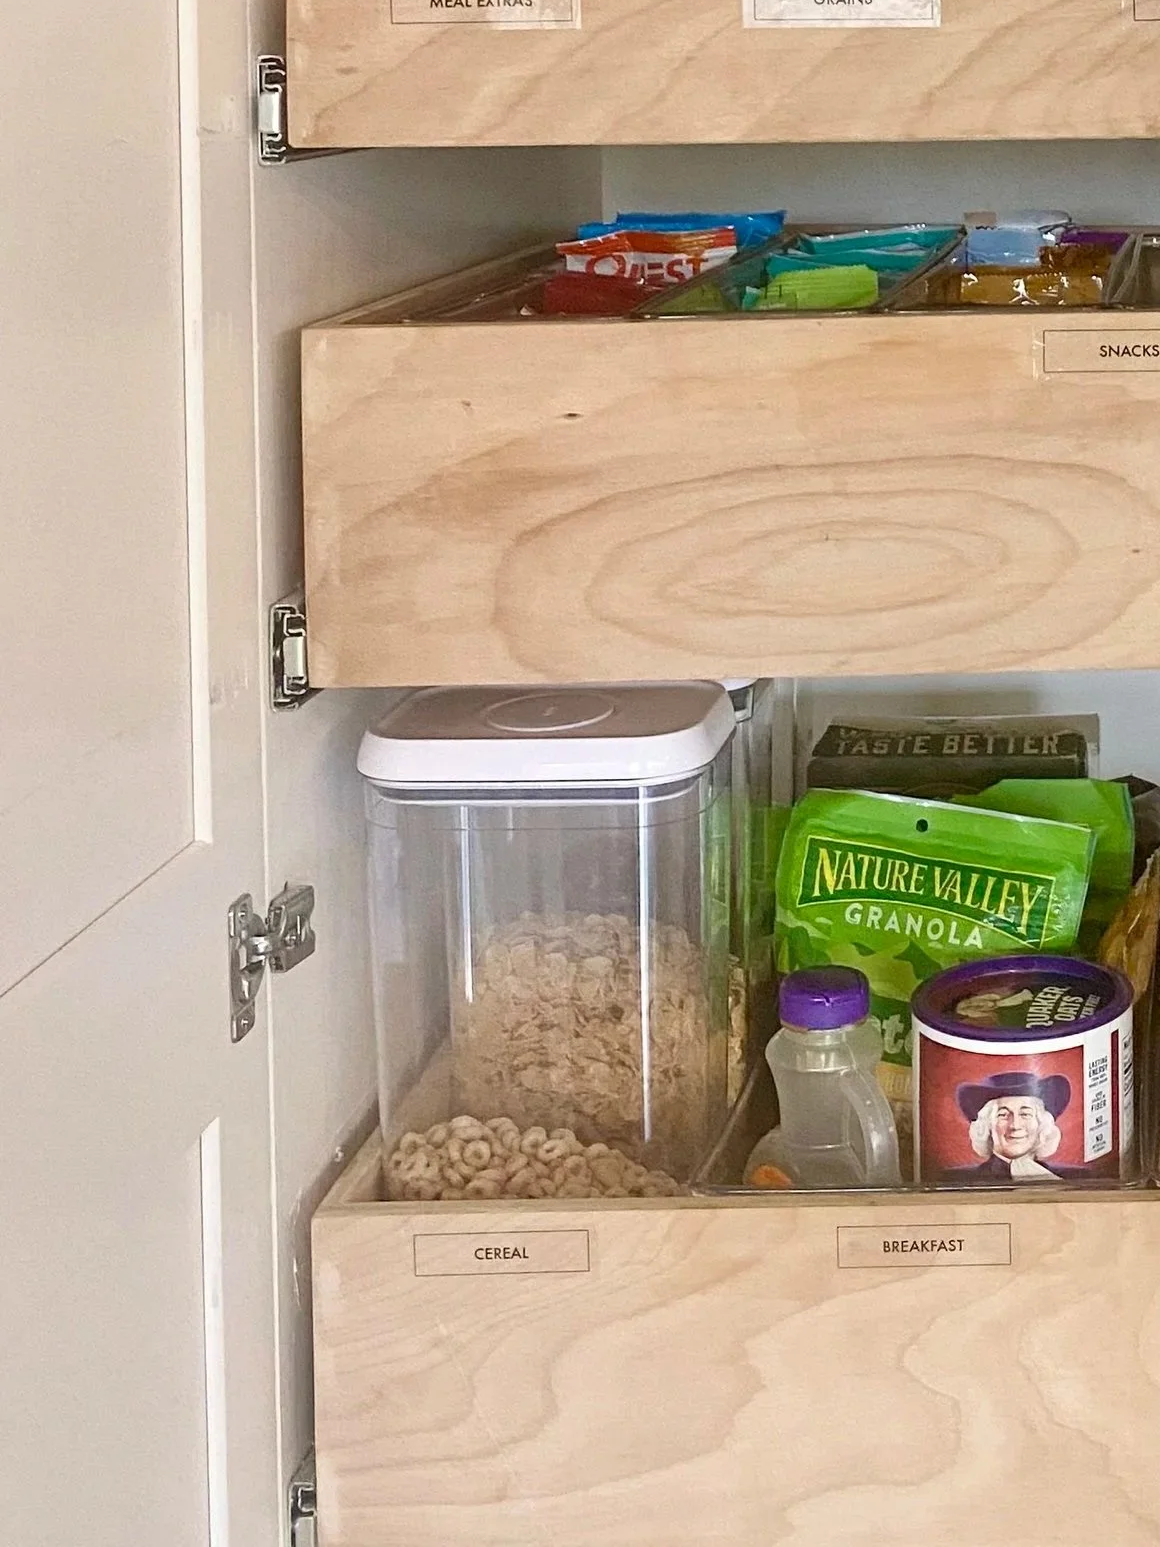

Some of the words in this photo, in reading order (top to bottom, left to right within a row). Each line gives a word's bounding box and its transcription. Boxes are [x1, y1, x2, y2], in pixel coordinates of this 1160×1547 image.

[585, 254, 709, 285] QUEST
[1099, 344, 1160, 358] SNACKS
[838, 735, 932, 755] TASTE
[943, 733, 1060, 755] BETTER
[812, 848, 928, 897] NATURE
[933, 866, 1045, 936] VALLEY
[844, 903, 983, 950] GRANOLA
[1026, 986, 1072, 1029] QUAKER
[1054, 994, 1083, 1022] OATS
[1088, 1055, 1108, 1070] LASTING
[1088, 1065, 1108, 1079] ENERGY
[1091, 1099, 1107, 1112] FIBER
[474, 1245, 529, 1260] CEREAL
[883, 1239, 965, 1253] BREAKFAST
